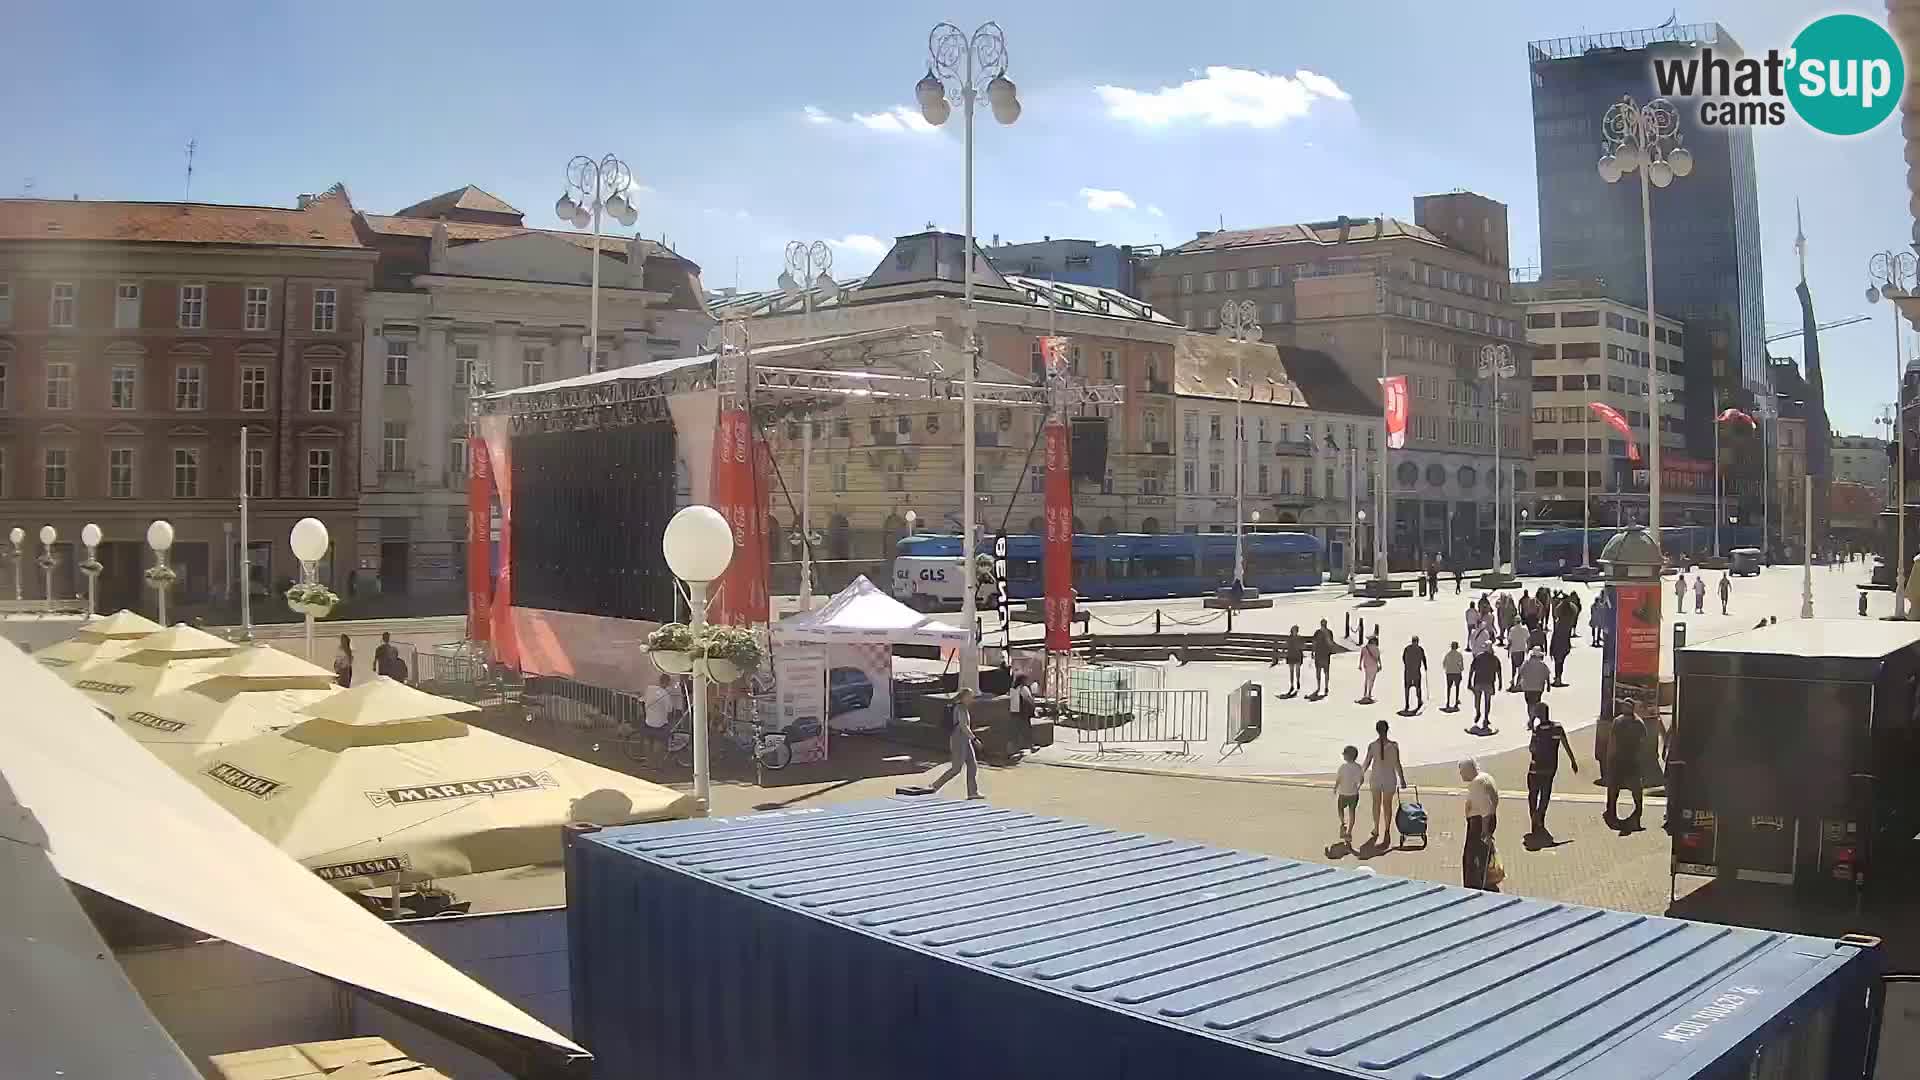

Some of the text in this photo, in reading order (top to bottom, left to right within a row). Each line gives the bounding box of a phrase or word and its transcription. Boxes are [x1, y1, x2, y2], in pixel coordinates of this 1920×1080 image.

[919, 568, 945, 581] GLS
[213, 764, 273, 794] MARASKA
[398, 776, 531, 802] MARASKA
[319, 858, 396, 880] MARASKA
